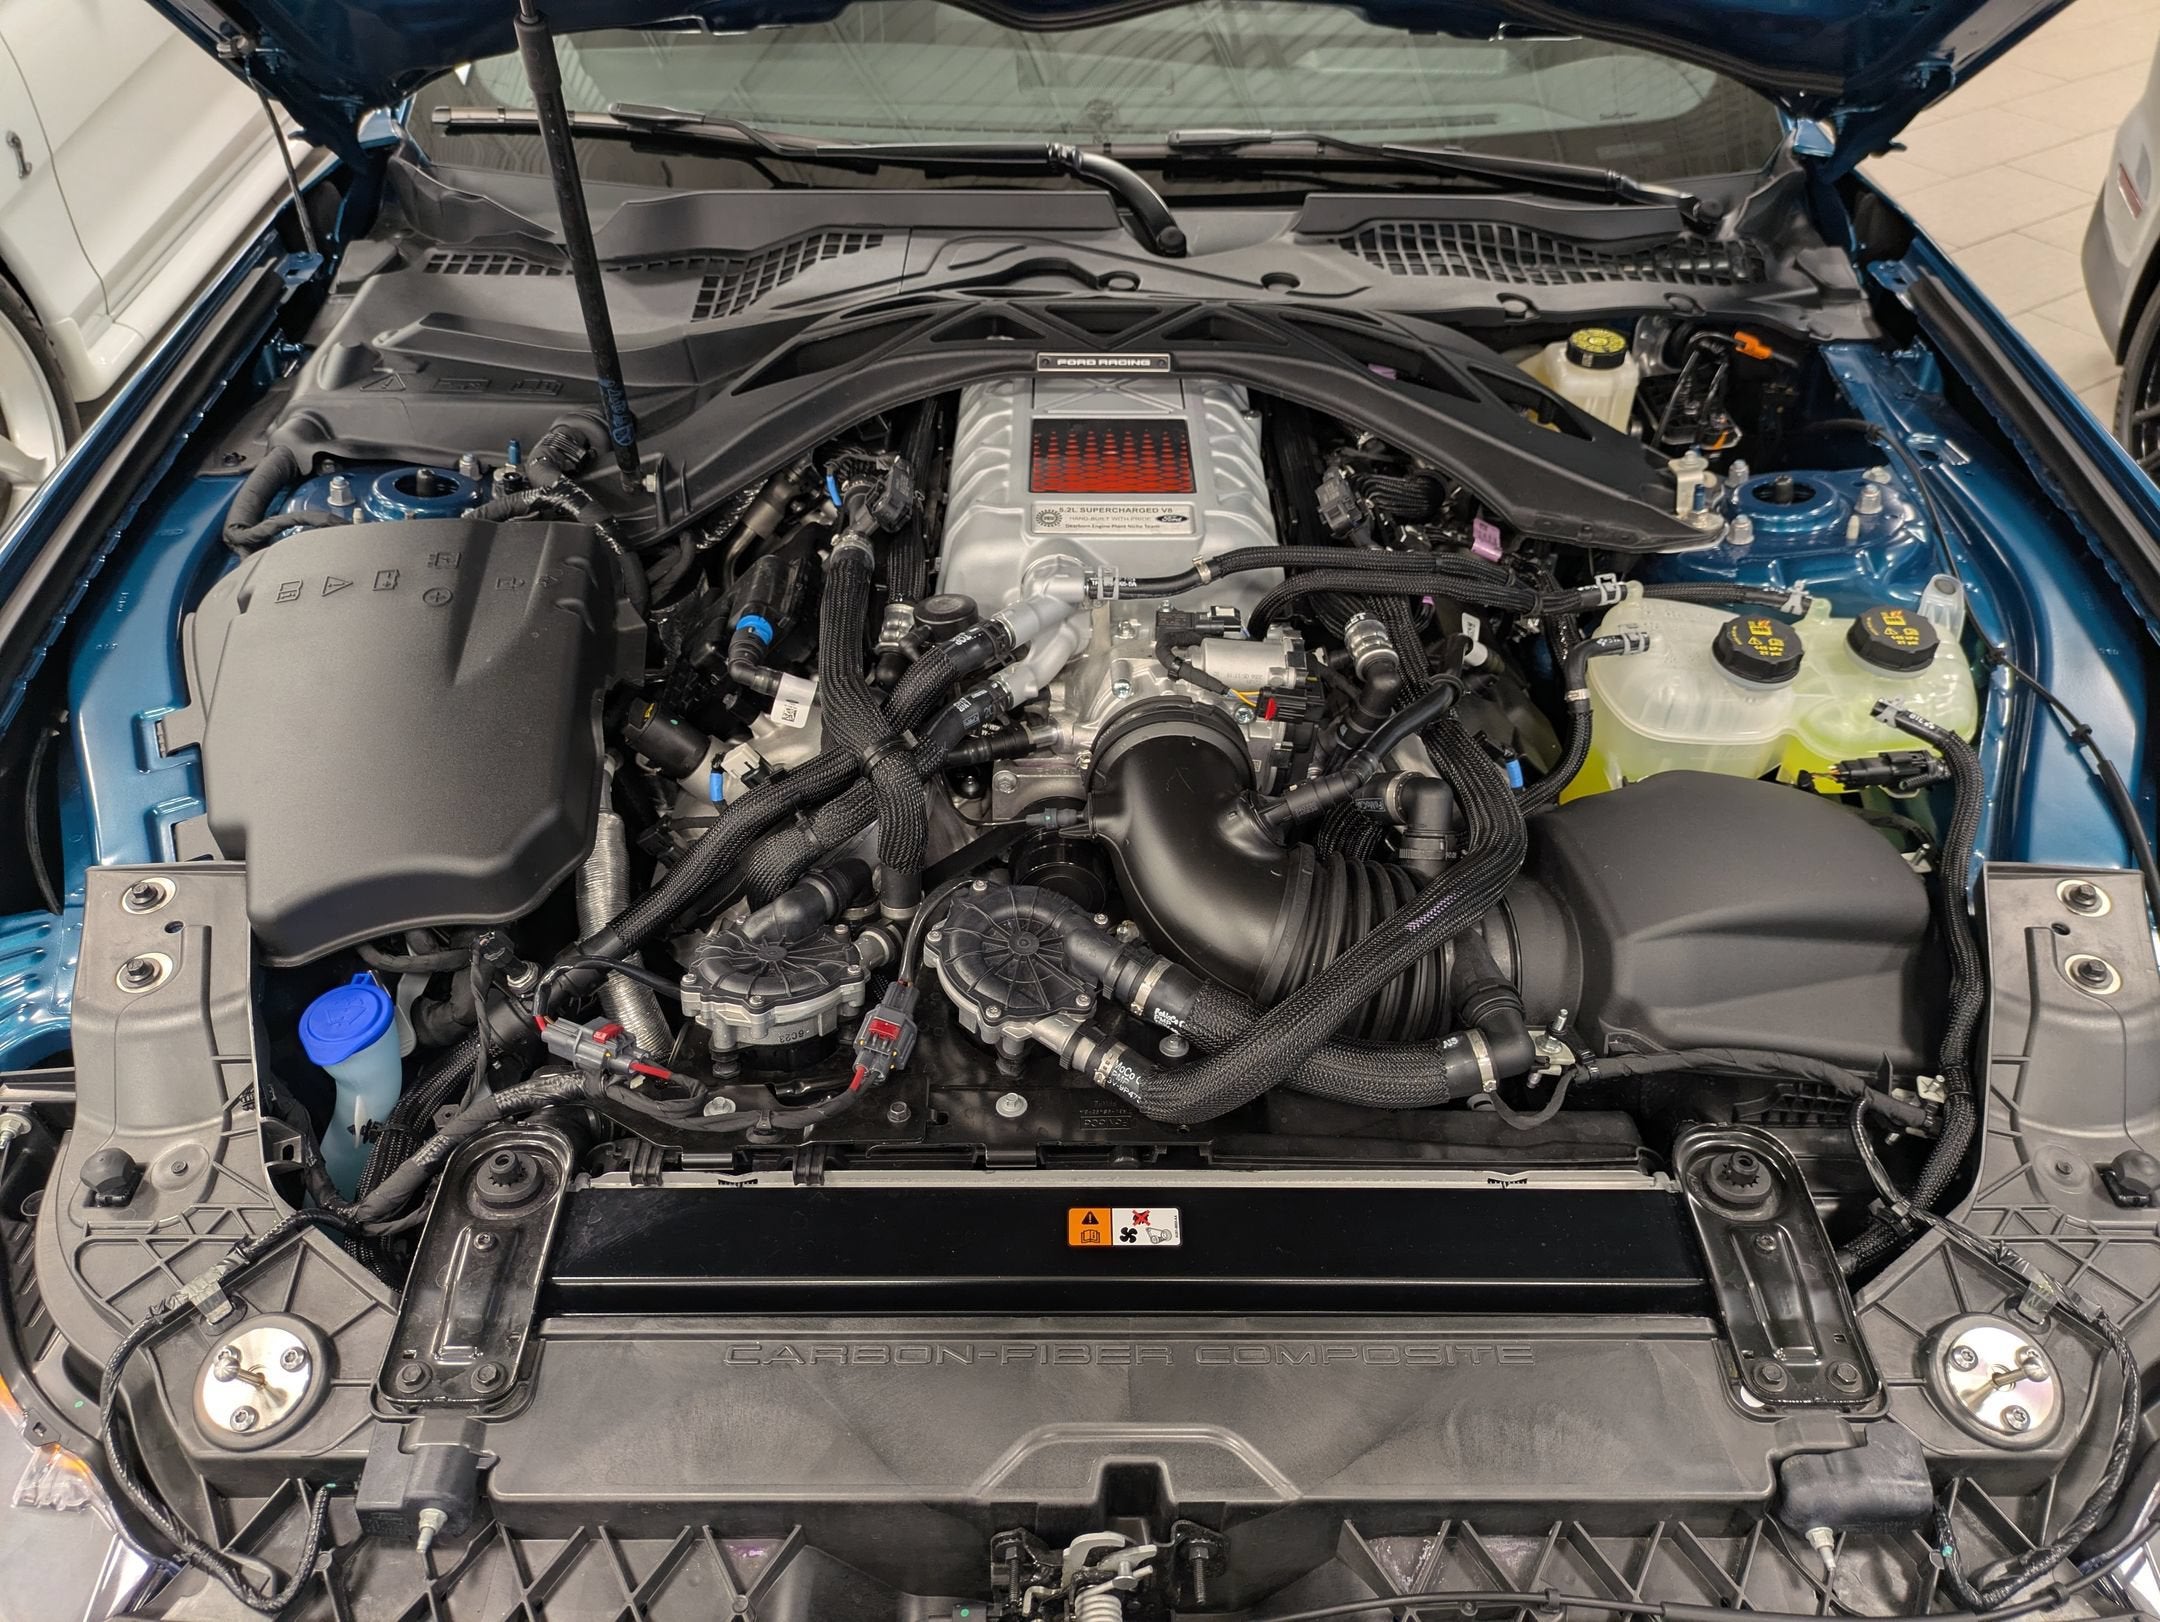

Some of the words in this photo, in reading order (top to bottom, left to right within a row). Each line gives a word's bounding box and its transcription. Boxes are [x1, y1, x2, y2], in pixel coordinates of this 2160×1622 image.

[1056, 358, 1097, 367] FORD
[1098, 358, 1152, 367] RACING
[1058, 506, 1078, 514] 5.2L
[1079, 506, 1160, 514] SUPERCHARGED
[1160, 506, 1174, 514] V8
[724, 1344, 1174, 1366] CARBON-FIBER
[1195, 1344, 1536, 1366] COMPOSITE
